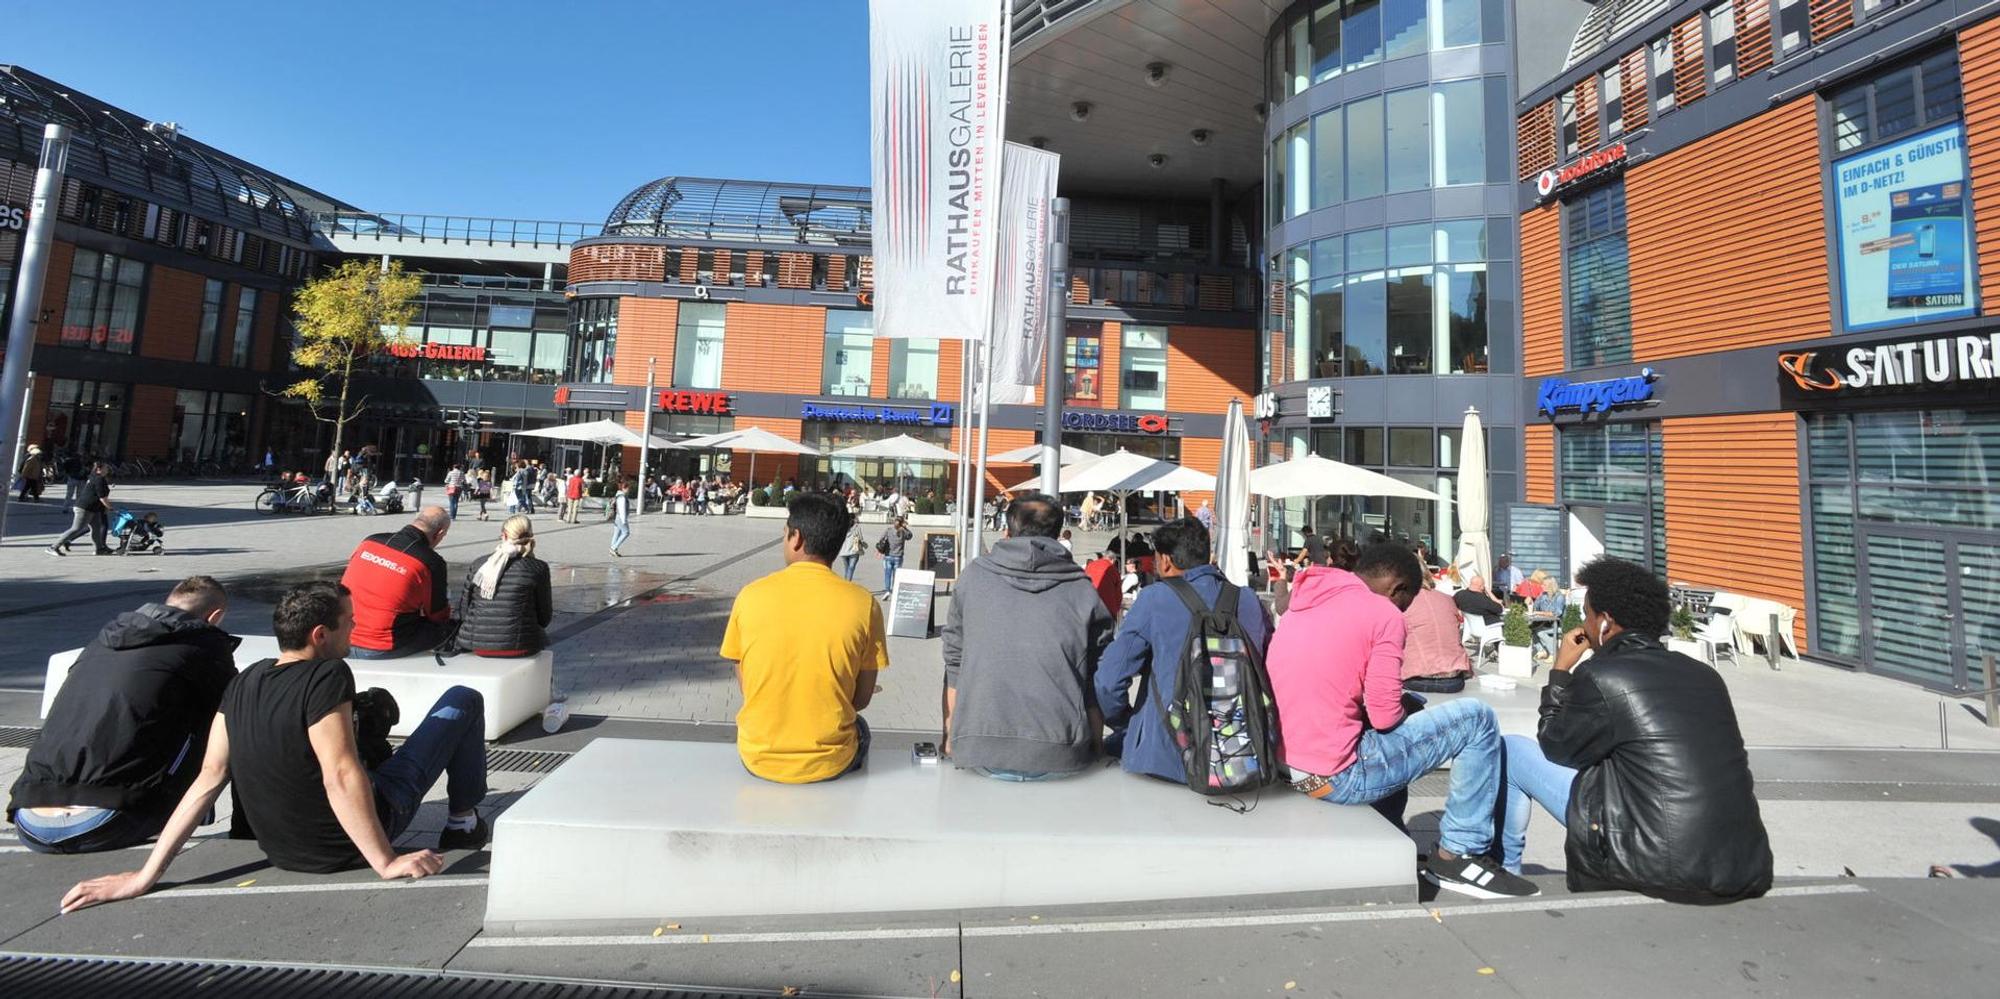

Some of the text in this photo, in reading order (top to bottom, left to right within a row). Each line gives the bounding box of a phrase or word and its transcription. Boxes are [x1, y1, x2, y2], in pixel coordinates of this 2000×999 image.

[946, 25, 972, 295] RATHAUSGALERIE
[970, 24, 988, 295] EINKAUFEN MITTEN IN LEVERKUSEN
[1559, 143, 1627, 183] vodafone
[1843, 158, 1890, 182] EINFACH
[1895, 154, 1904, 167] &
[1844, 171, 1905, 198] IM D-NETZ!
[1023, 196, 1039, 339] RATHAUSGALERIE
[1925, 295, 1962, 306] SATURN
[658, 390, 728, 414] REWE
